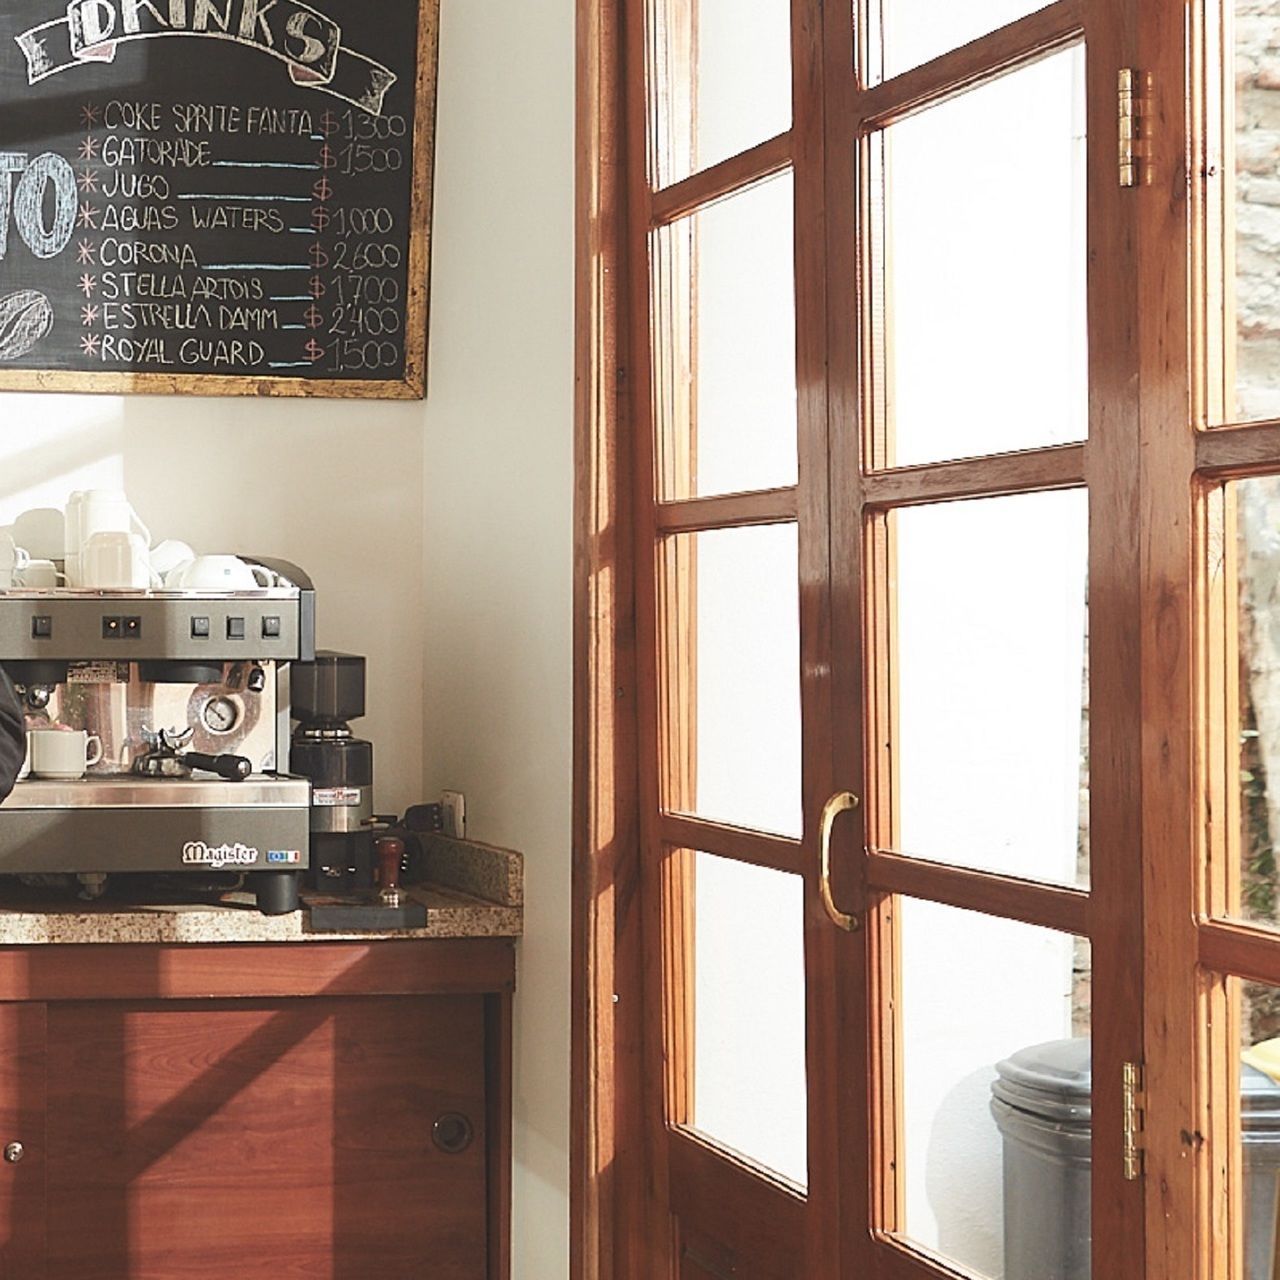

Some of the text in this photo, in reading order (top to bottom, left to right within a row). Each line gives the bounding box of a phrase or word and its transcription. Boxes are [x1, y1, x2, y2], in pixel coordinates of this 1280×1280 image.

[104, 100, 161, 130] COKE
[173, 104, 241, 133] SPRITE
[247, 107, 312, 135] FANTA
[102, 135, 211, 167] GATORADE
[102, 170, 169, 200] JUGO
[101, 204, 178, 232] AGUAS
[192, 206, 284, 233] WATERS
[100, 238, 197, 270] CORONA
[101, 272, 187, 299] STELLA
[103, 302, 212, 329] ESTRELLA
[220, 305, 278, 331] DAMM
[101, 334, 174, 363] ROYAL
[179, 338, 265, 367] GUARD
[184, 842, 256, 866] Magister
